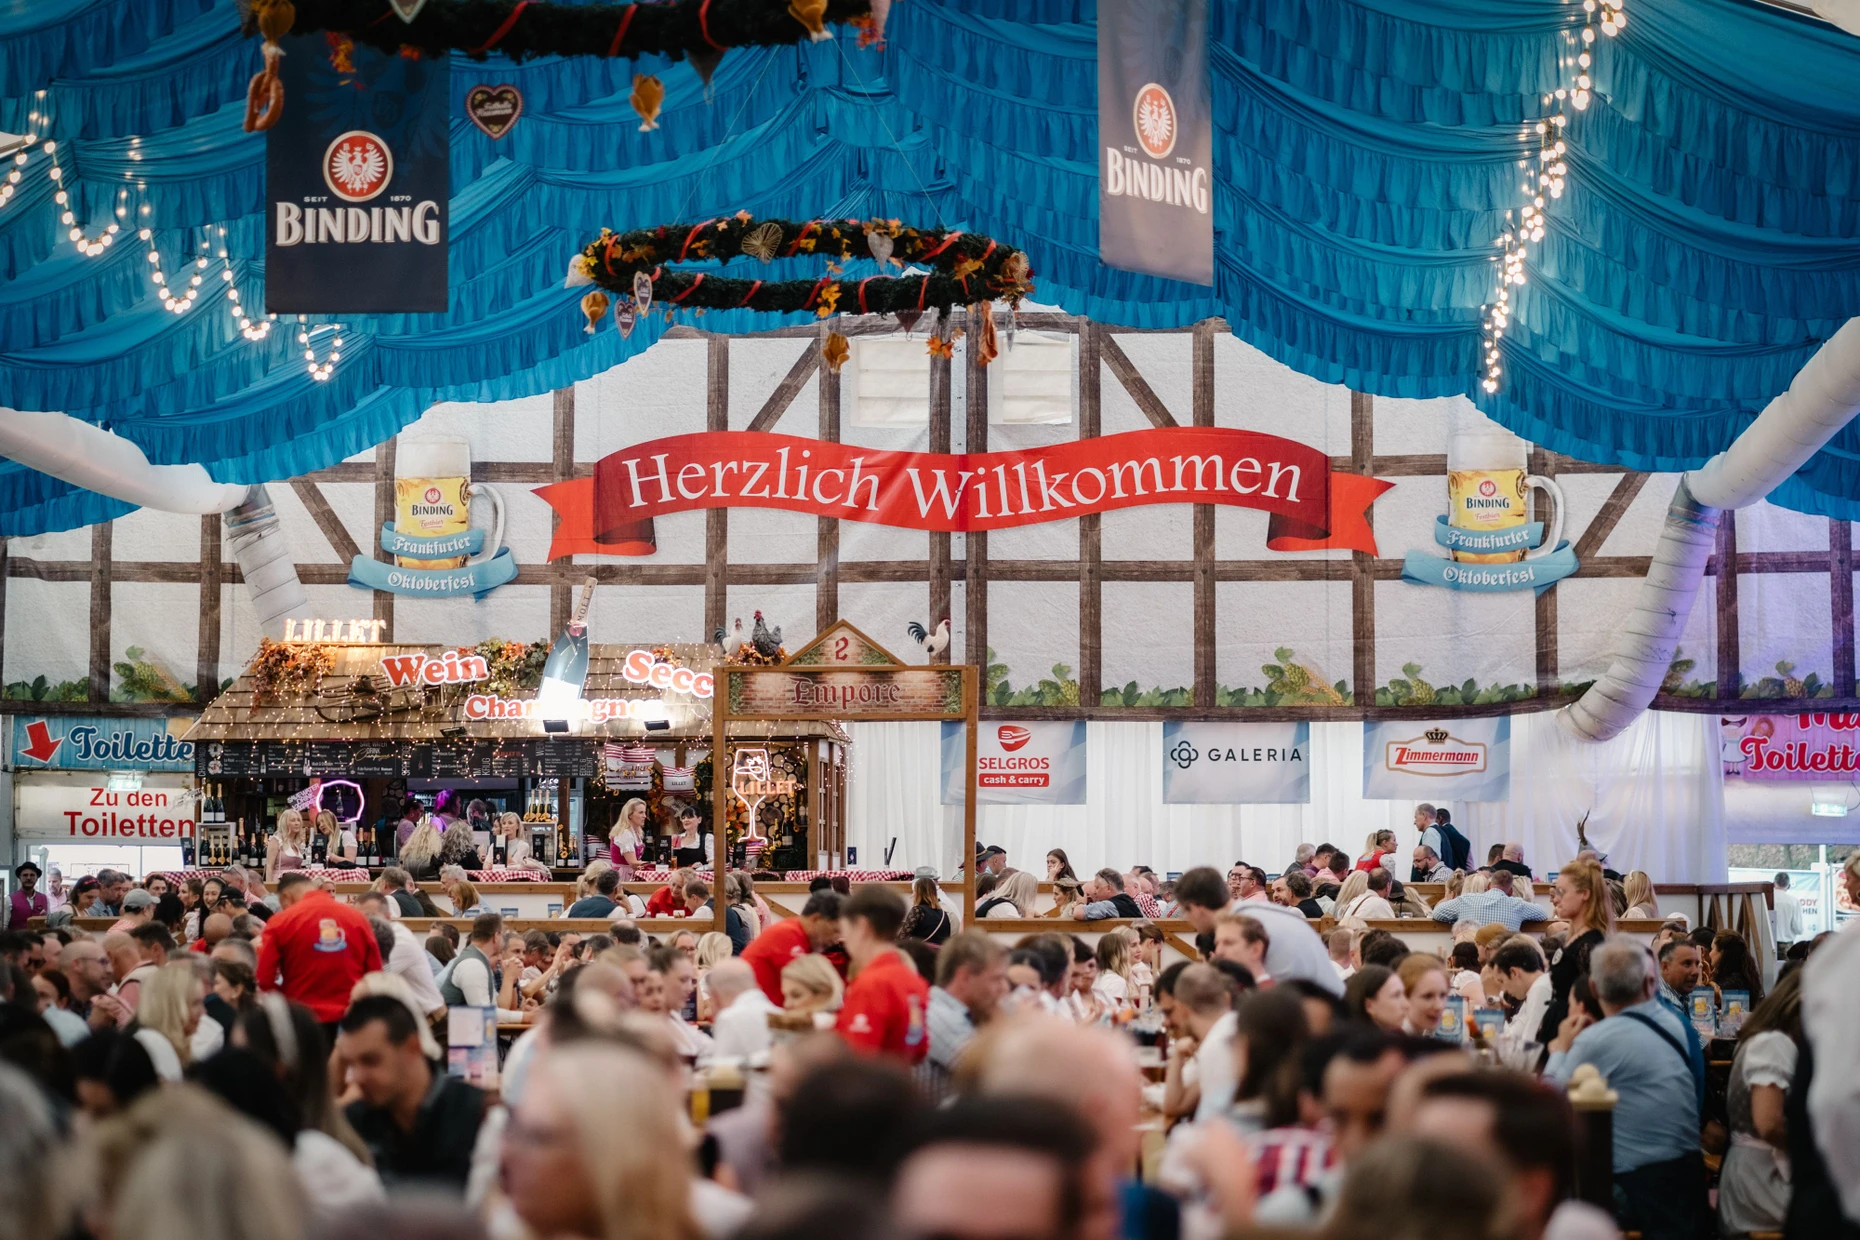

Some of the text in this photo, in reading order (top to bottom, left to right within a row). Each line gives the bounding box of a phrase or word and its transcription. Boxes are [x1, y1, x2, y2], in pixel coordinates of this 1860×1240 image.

[1124, 145, 1191, 165] SEIT 1870
[1107, 147, 1207, 214] BINDING
[276, 200, 440, 246] BINDING
[622, 446, 1301, 520] Herzlich Willkommen
[412, 505, 453, 516] BINDING
[1466, 497, 1510, 509] BINDING
[392, 536, 471, 556] Frankfurter
[1446, 529, 1530, 549] Frankfurter
[388, 571, 476, 593] Oktoberfest
[1443, 566, 1535, 587] Oktoberfest
[283, 618, 387, 642] LILLET
[835, 636, 849, 661] 2
[381, 651, 489, 687] Wein
[623, 650, 714, 698] Secc
[790, 676, 901, 710] Empore
[979, 758, 1050, 770] SELGROS
[1208, 748, 1302, 762] GALERIA
[1395, 747, 1479, 765] Zimmermann
[482, 757, 491, 776] KRUG
[739, 780, 797, 795] LILLET
[984, 775, 1045, 786] cash & carry
[90, 787, 118, 807] Zu
[126, 790, 167, 807] den
[63, 811, 195, 837] Toiletten
